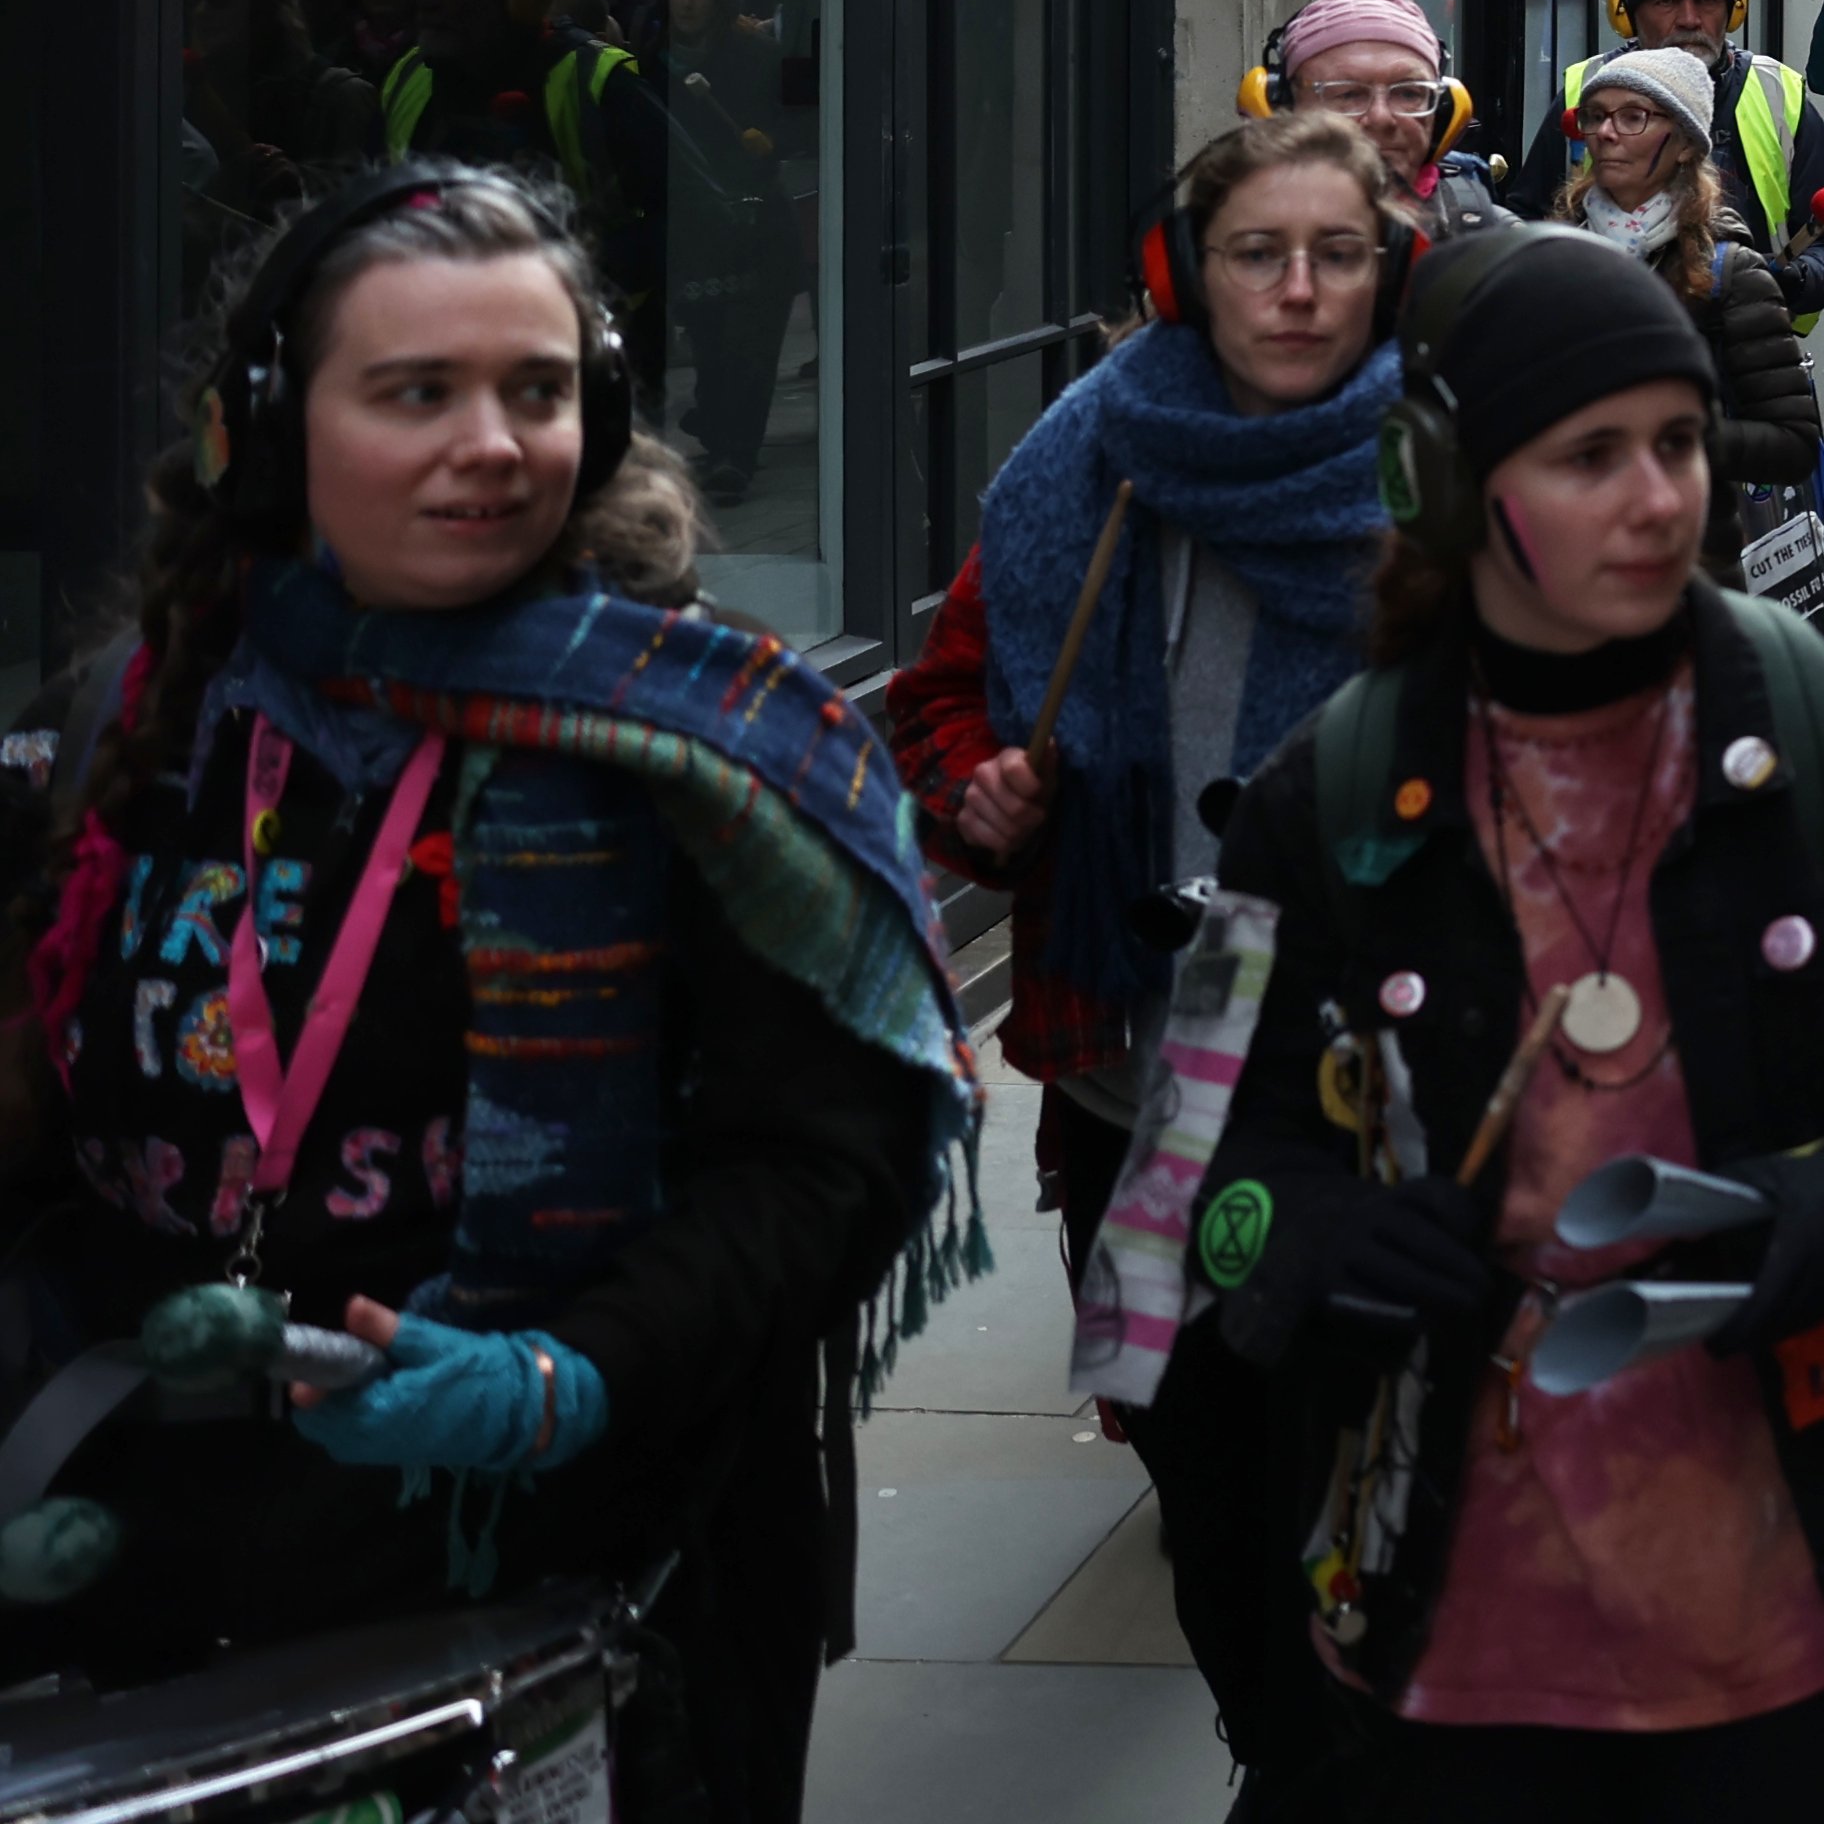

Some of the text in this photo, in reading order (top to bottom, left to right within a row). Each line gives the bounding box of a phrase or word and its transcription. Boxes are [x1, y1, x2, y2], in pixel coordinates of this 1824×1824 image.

[1751, 532, 1813, 579] CUT THE TIES
[1780, 585, 1811, 609] OSSIL
